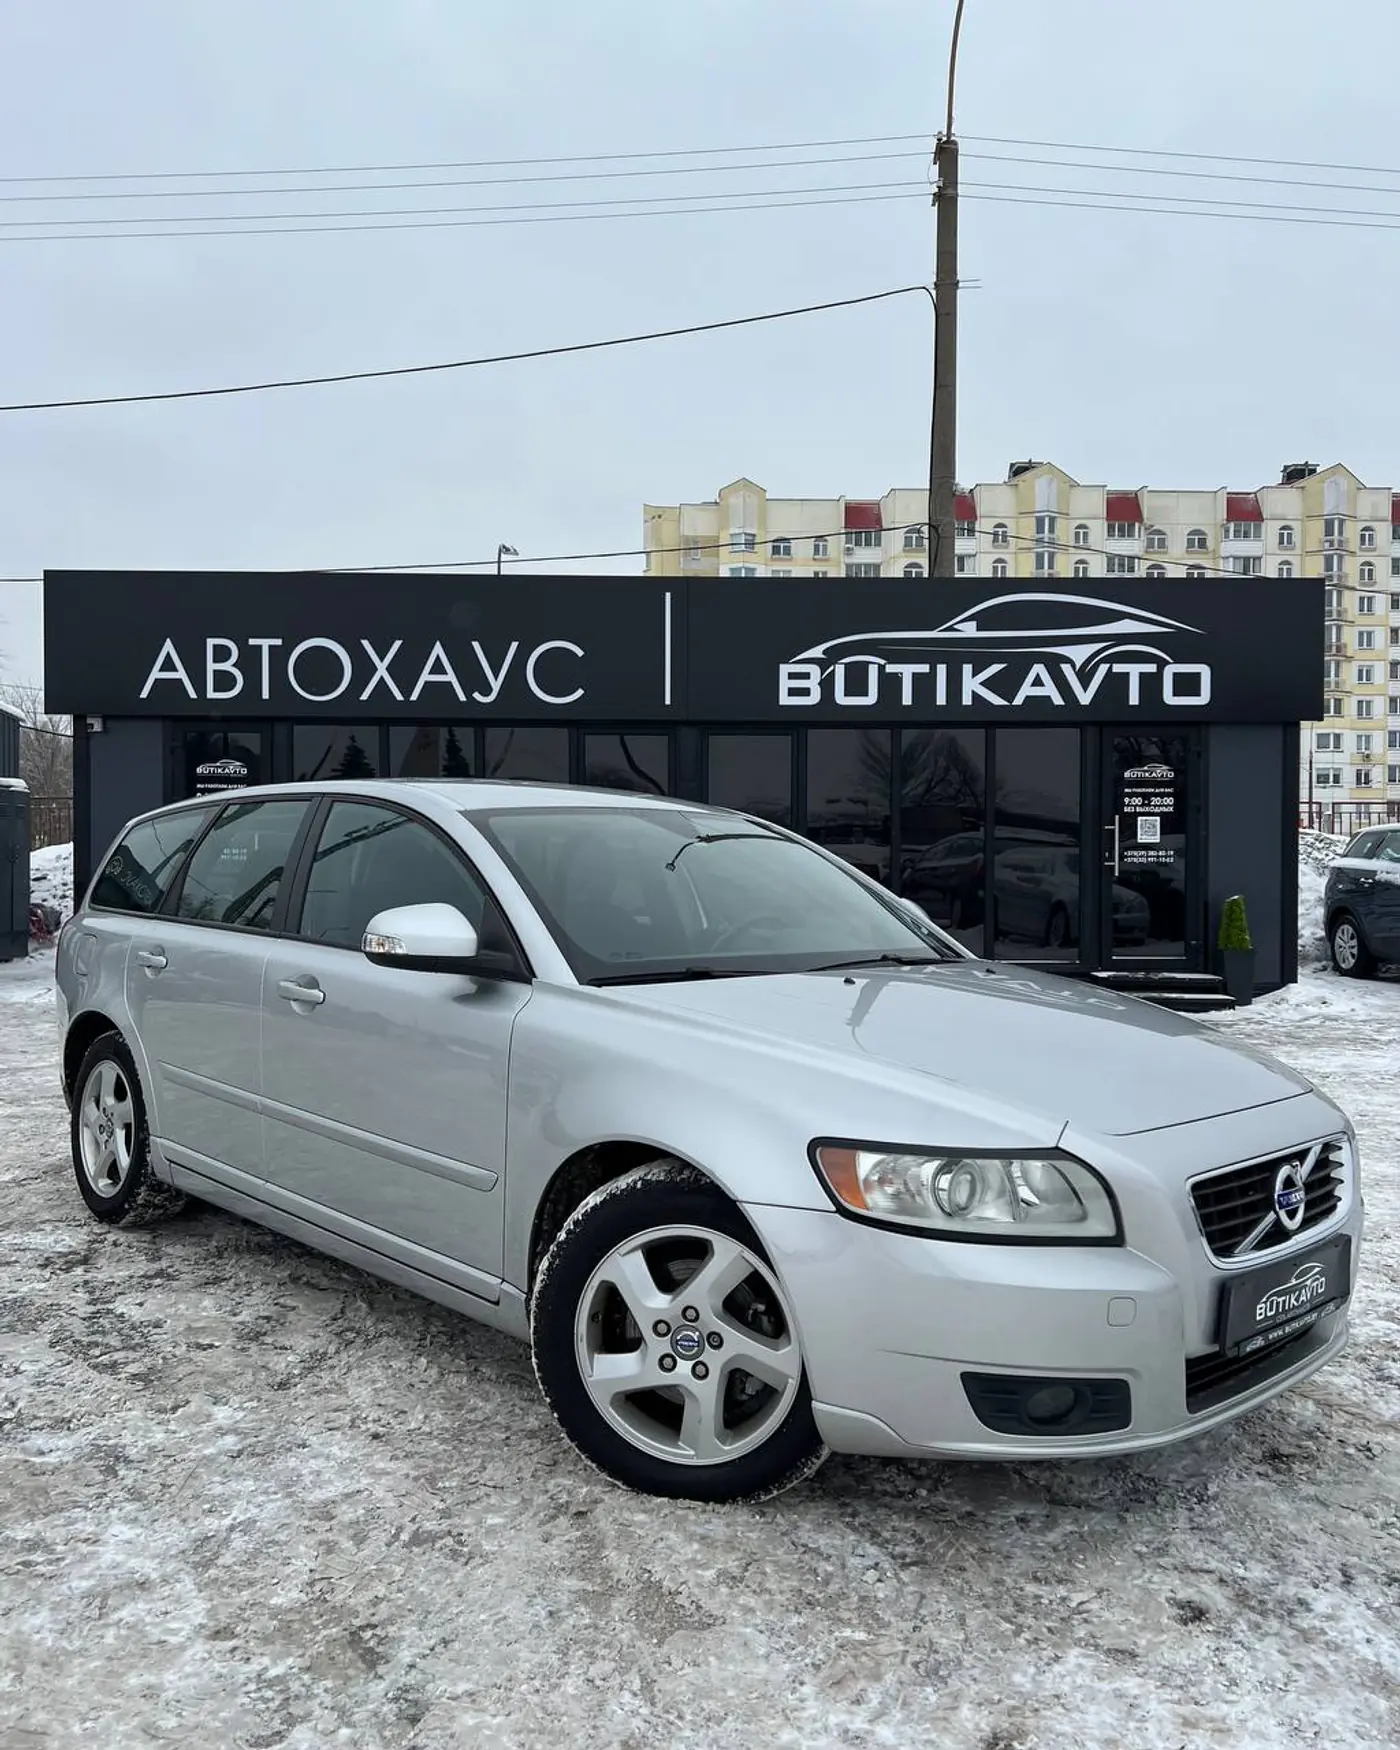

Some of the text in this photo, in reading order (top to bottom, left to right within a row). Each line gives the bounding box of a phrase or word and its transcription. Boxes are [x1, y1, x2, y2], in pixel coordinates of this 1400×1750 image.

[139, 637, 586, 705] АВТОХАУС
[778, 662, 1211, 707] BUTIKAVTO
[196, 766, 248, 774] BUTIKAVTO
[1124, 797, 1143, 805] 9:00
[1150, 797, 1175, 805] 20:00
[1256, 1276, 1326, 1321] BUTIKAVTO
